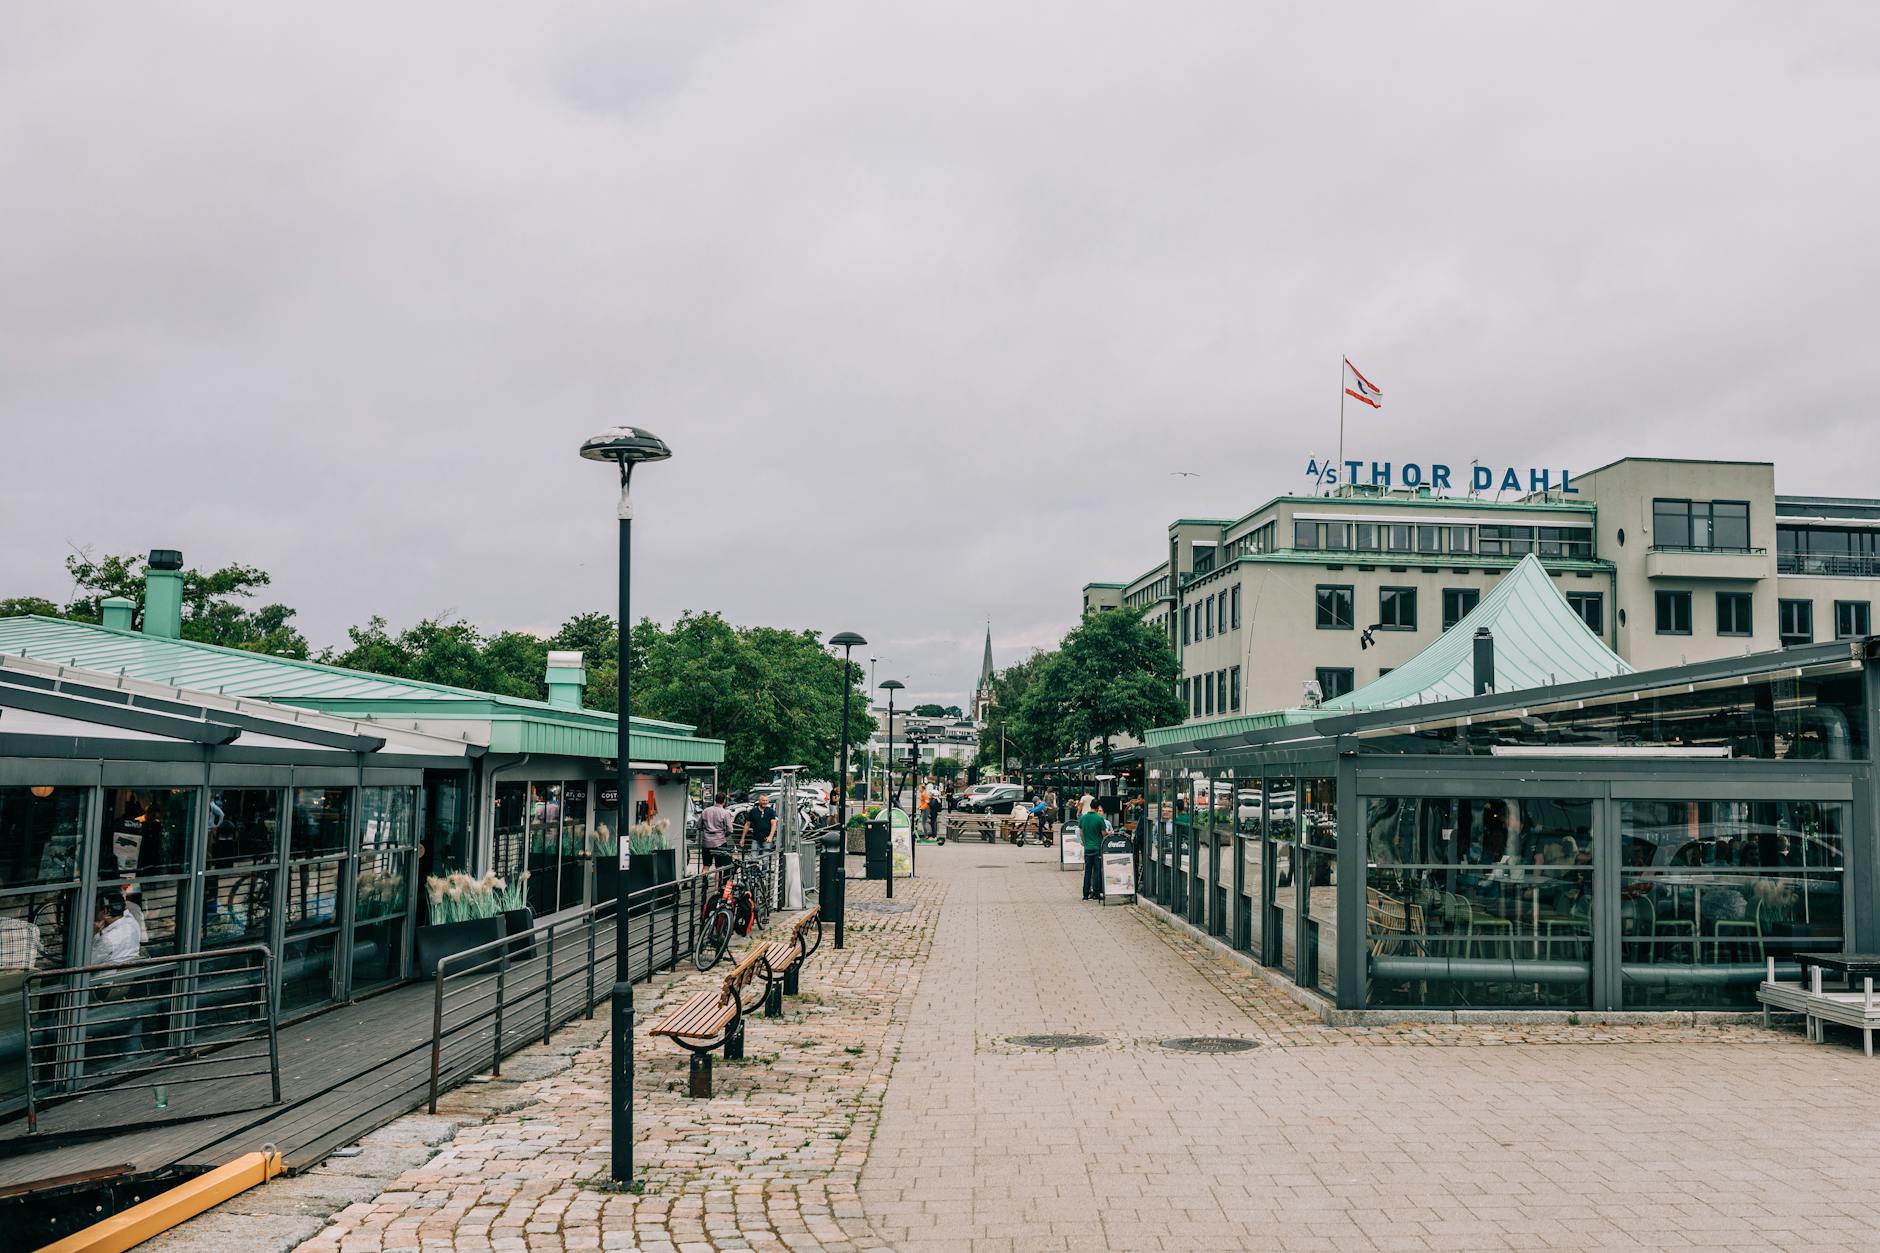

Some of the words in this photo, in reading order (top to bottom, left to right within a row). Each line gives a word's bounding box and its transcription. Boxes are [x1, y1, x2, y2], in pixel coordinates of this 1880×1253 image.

[1306, 459, 1337, 485] A/S
[1345, 461, 1451, 488] THOR
[1474, 466, 1579, 493] DAHL
